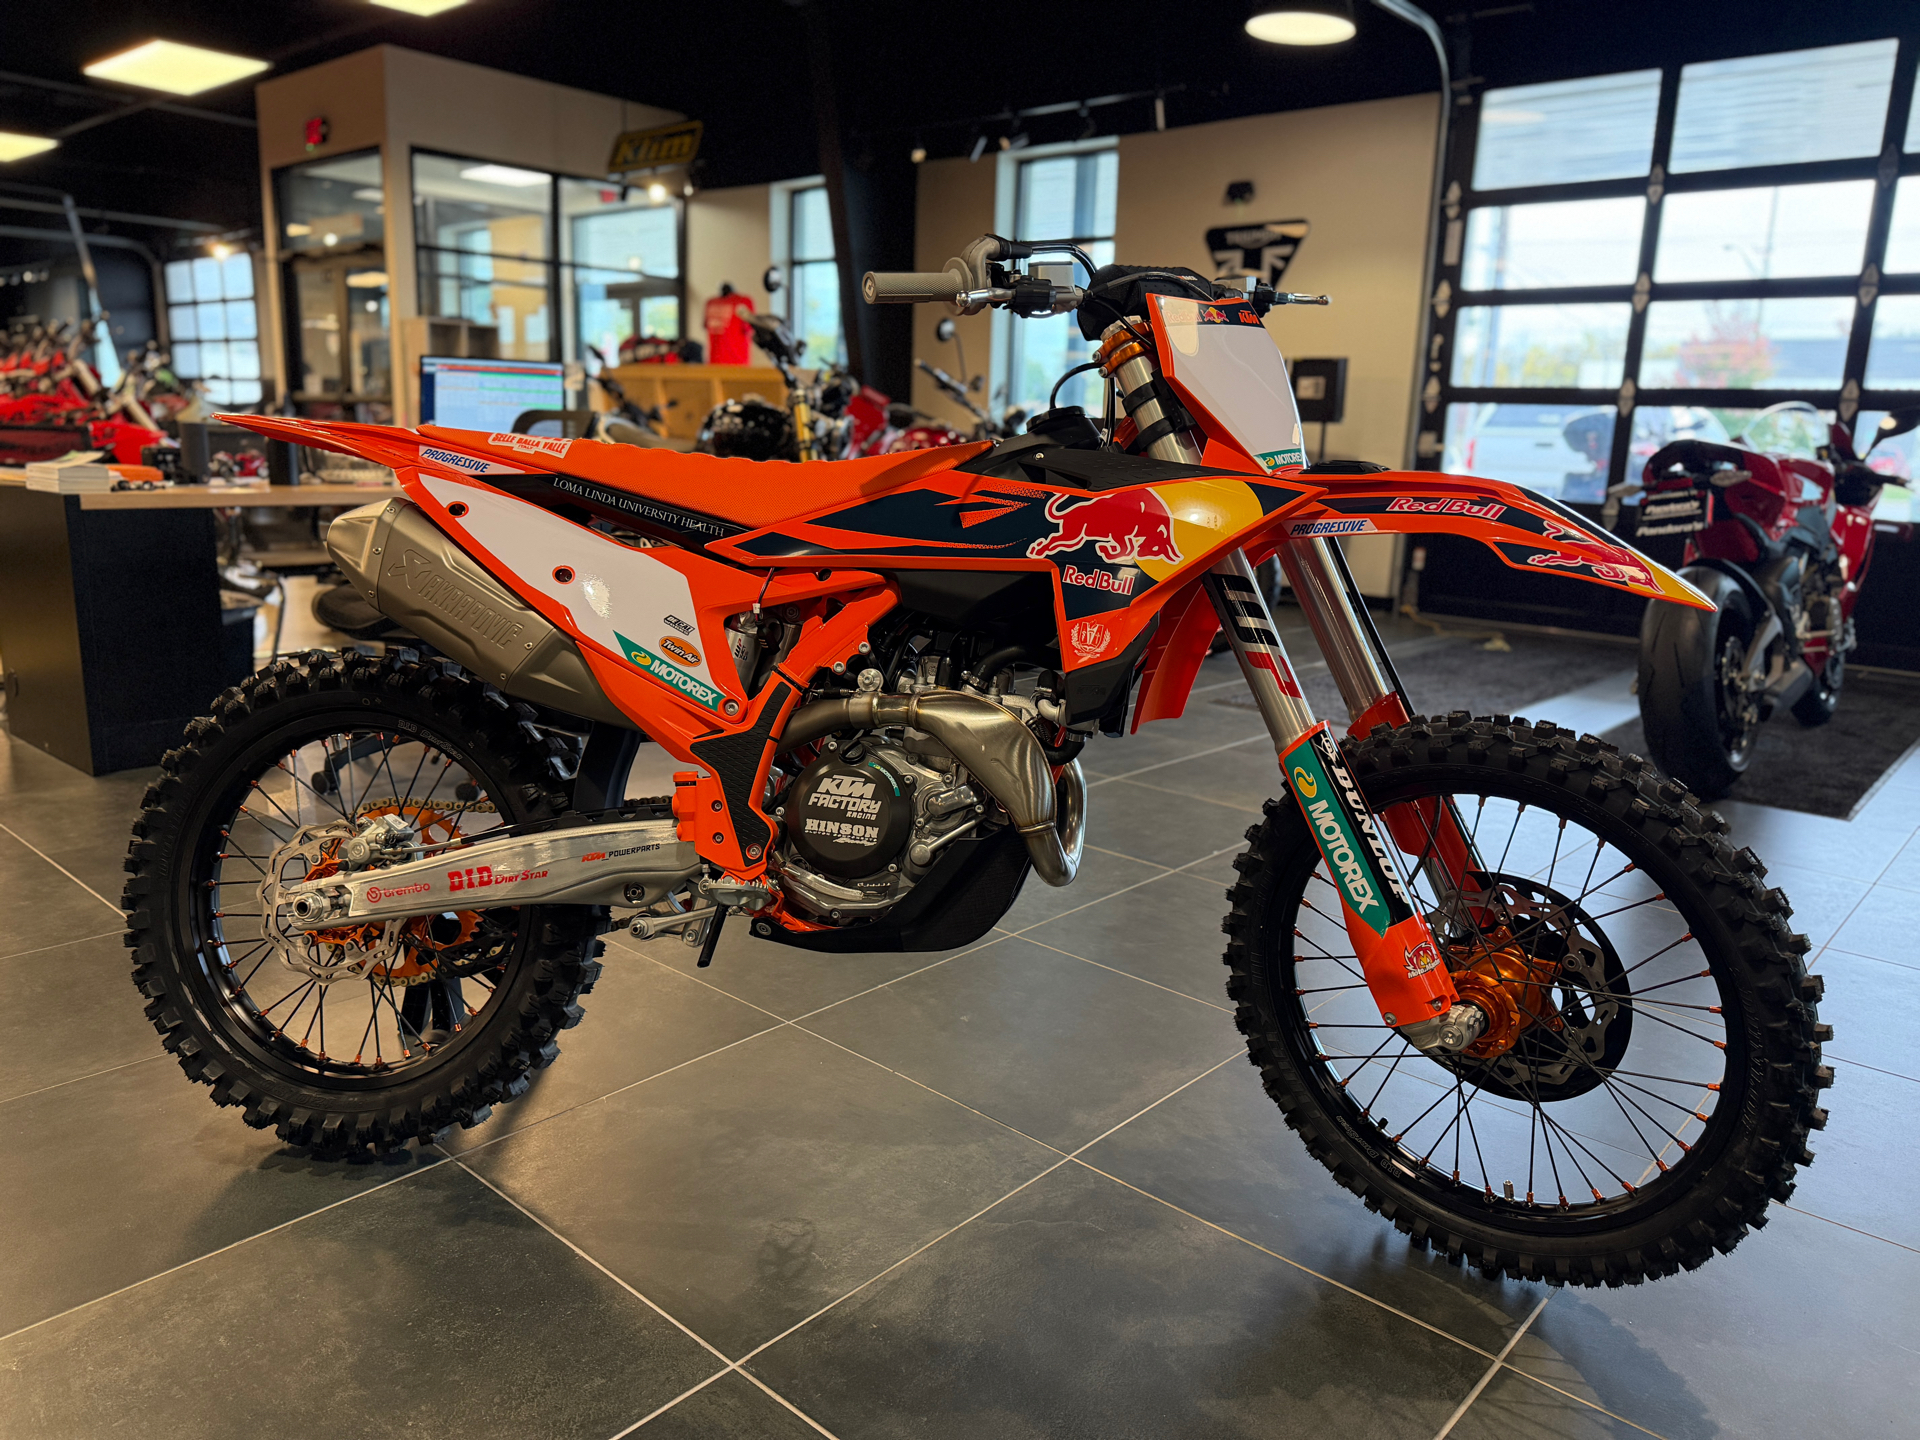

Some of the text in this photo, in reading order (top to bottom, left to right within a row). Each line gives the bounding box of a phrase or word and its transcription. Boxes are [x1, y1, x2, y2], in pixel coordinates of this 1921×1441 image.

[1238, 310, 1260, 325] KTM
[542, 441, 568, 454] VALLE
[421, 448, 490, 473] PROGRESSIVE
[553, 477, 725, 537] LOMA LINDA UNIVERSITY HEALTH
[1290, 520, 1367, 535] PROGRESSIVE
[662, 638, 700, 664] Twin Air
[650, 659, 718, 706] MOTOREX
[816, 774, 876, 799] KTM
[807, 792, 882, 814] FACTORY
[846, 811, 877, 821] RACING
[805, 818, 880, 838] HINSON
[1331, 765, 1410, 905] DUNLOP
[1308, 799, 1380, 914] MOTOREX
[383, 882, 431, 898] brembo
